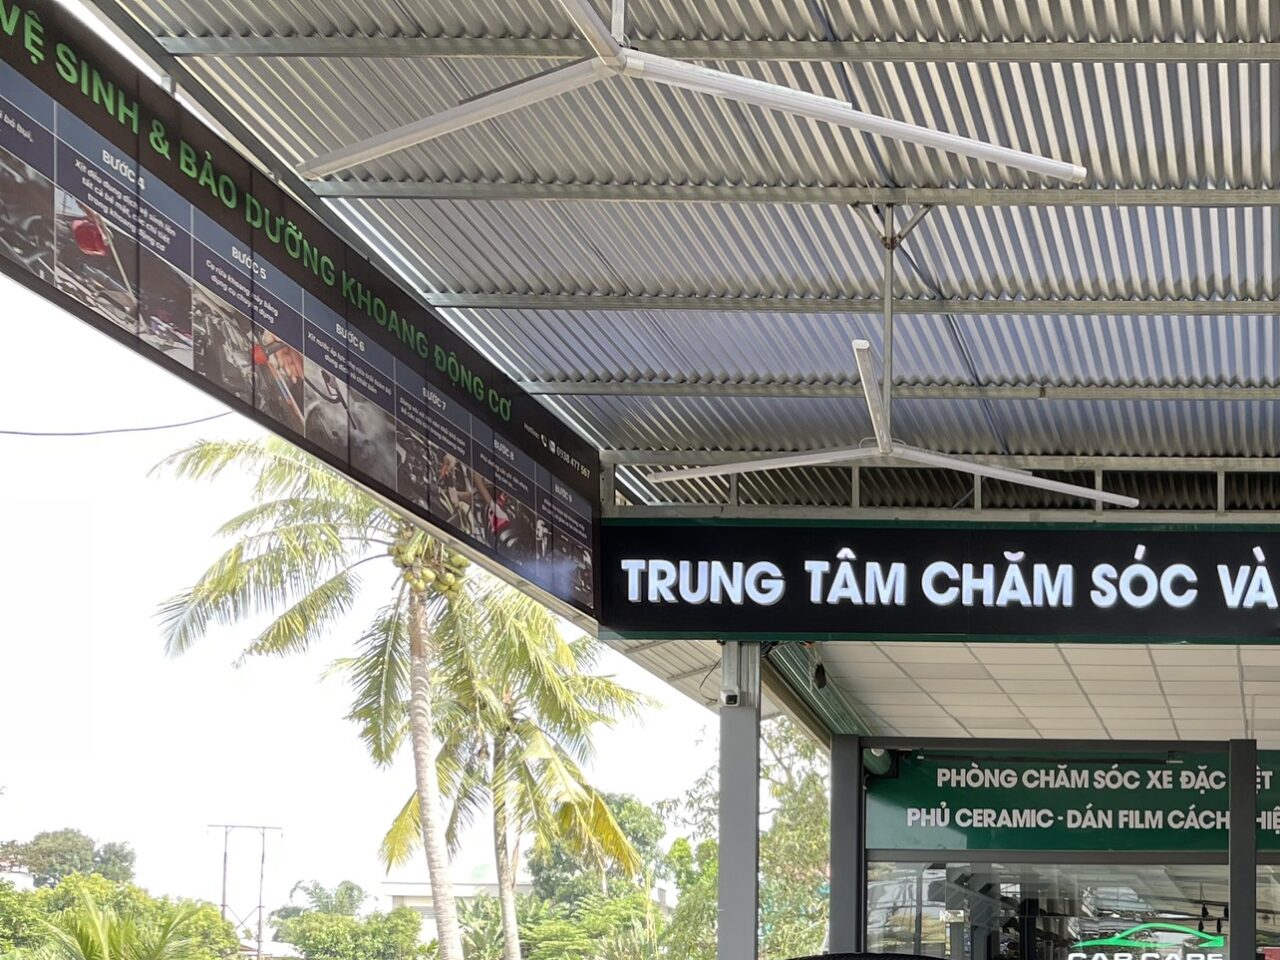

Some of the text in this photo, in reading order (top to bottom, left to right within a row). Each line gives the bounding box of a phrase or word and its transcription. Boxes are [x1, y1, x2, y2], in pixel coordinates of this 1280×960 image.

[102, 149, 145, 191] BƯỚC 4
[0, 0, 512, 421] VỆ SINH & BẢO DƯỠNG KHOANG ĐỘNG CƠ
[231, 246, 267, 280] BƯỚC 5
[359, 341, 365, 352] 6
[620, 558, 786, 604] TRUNG
[804, 547, 907, 607] TÂM
[921, 550, 1074, 607] CHĂM
[1089, 543, 1199, 609] SÓC
[1217, 545, 1279, 609] VÀ
[937, 761, 1018, 788] PHÒNG
[1021, 763, 1090, 788] CHĂM
[1093, 763, 1141, 789] SÓC
[1146, 769, 1173, 789] XE
[1179, 764, 1226, 794] ĐẶC
[906, 801, 951, 828] PHỦ
[955, 808, 1054, 828] CERAMIC
[1067, 803, 1113, 829] DÁN
[1118, 808, 1163, 829] FILM
[1167, 804, 1230, 829] CÁCH
